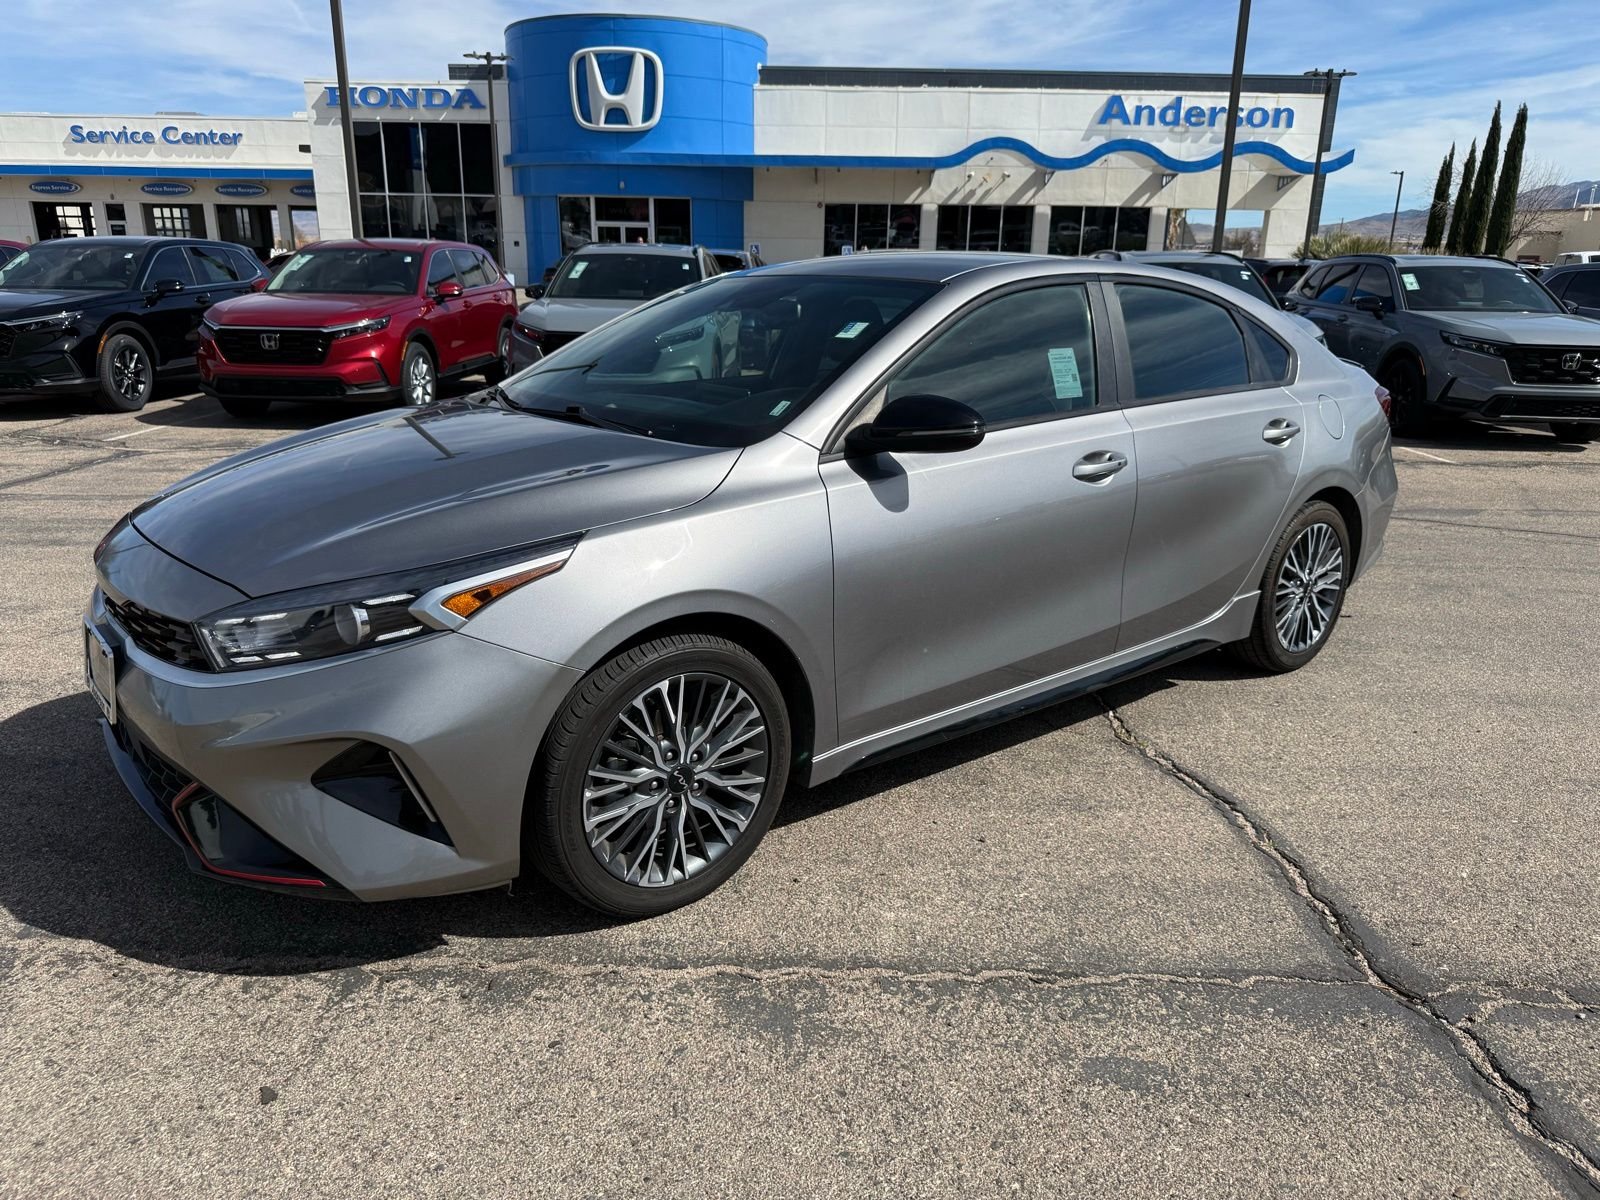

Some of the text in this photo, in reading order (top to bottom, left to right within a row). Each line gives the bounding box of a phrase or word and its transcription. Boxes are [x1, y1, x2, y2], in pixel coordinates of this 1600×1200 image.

[324, 86, 486, 109] HONDA
[70, 124, 243, 146] Service Center
